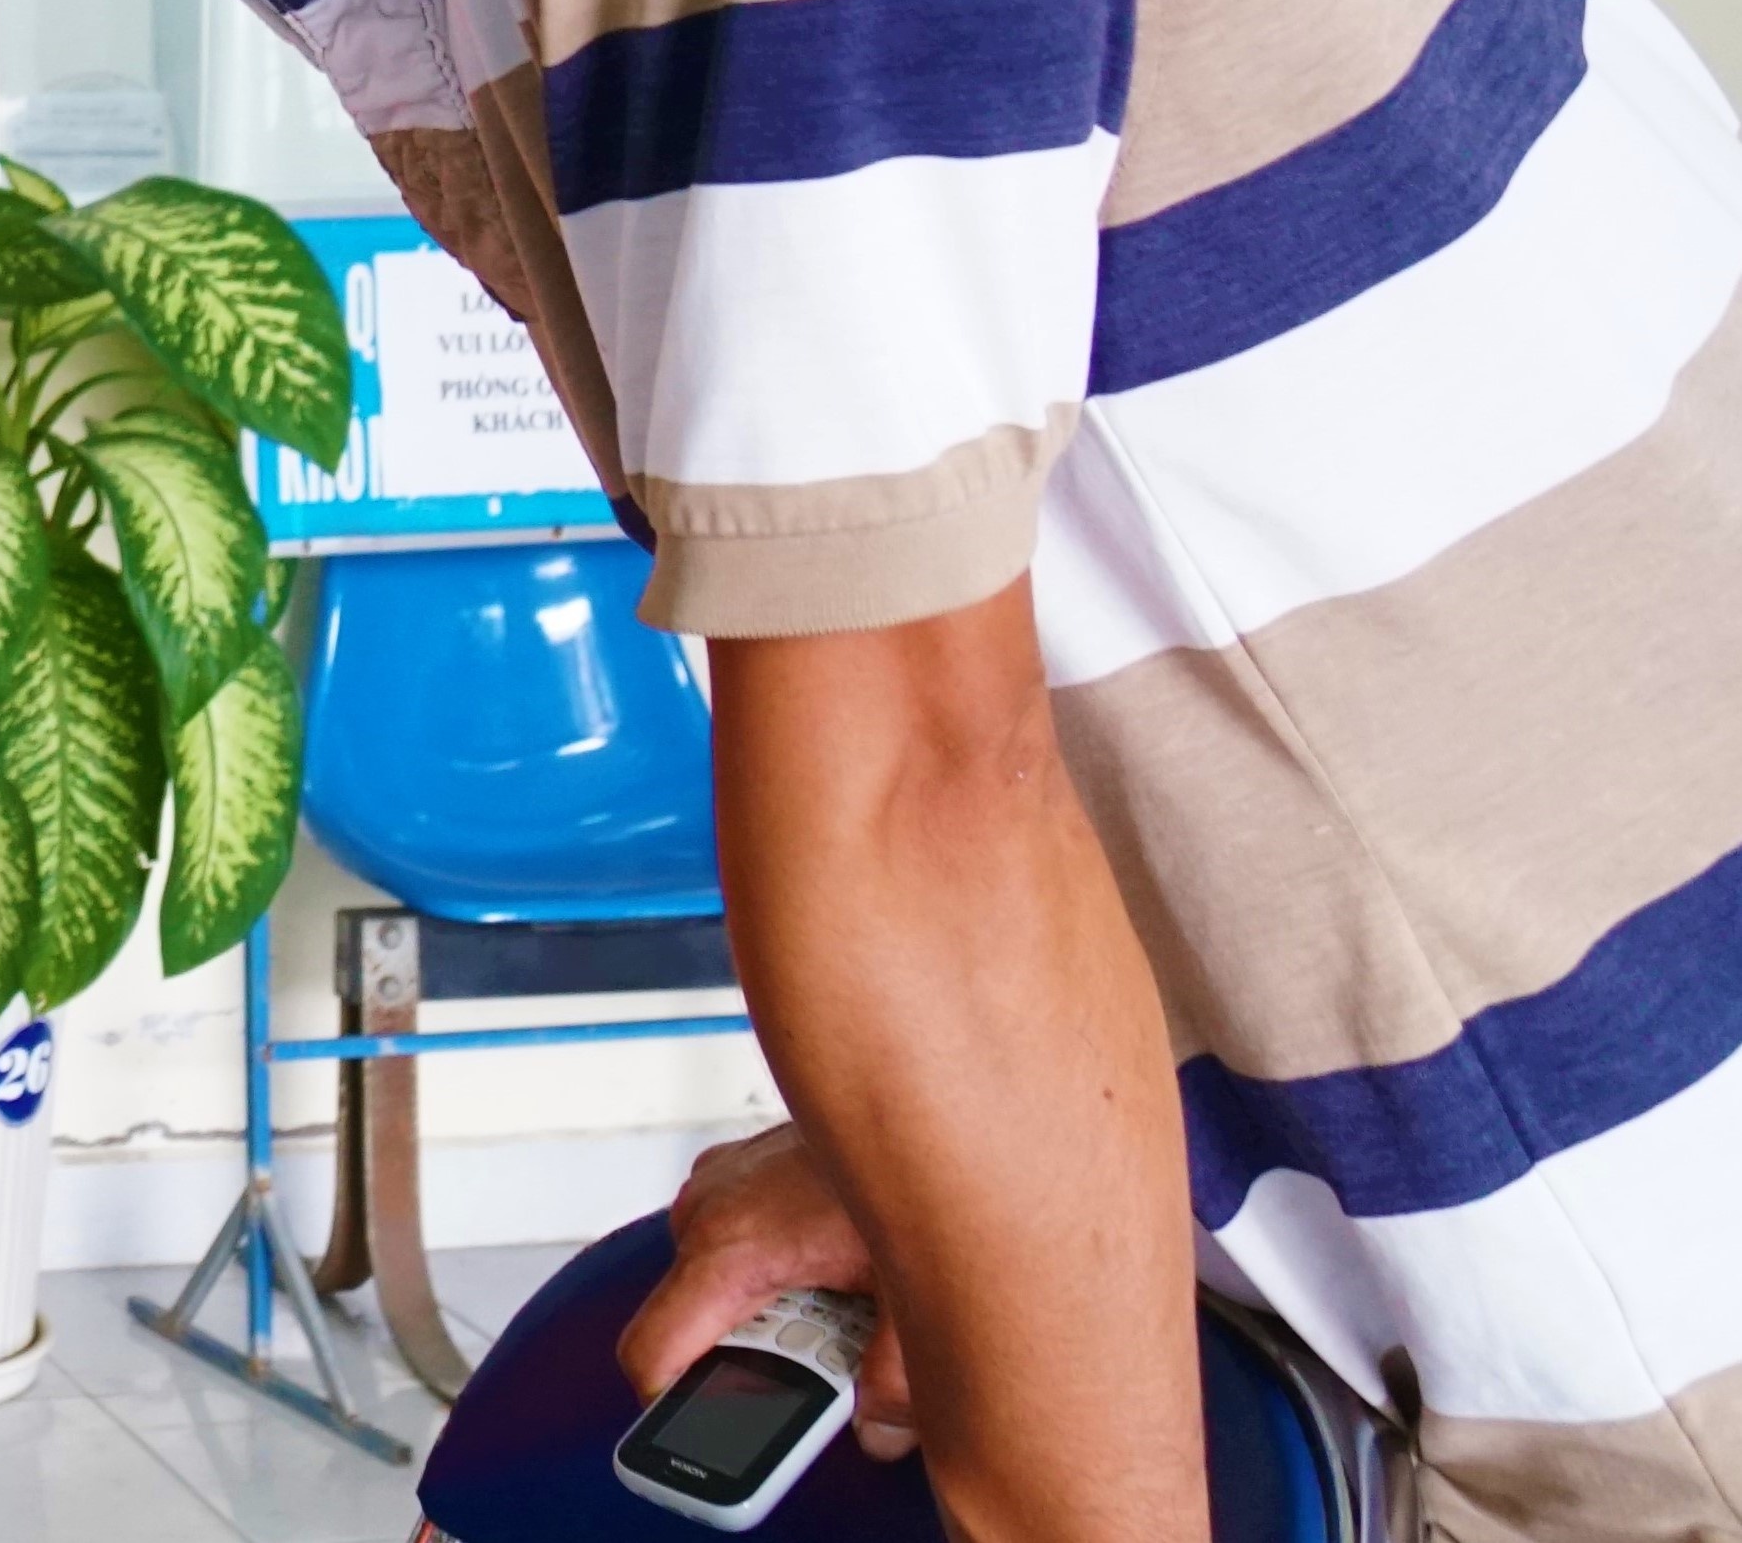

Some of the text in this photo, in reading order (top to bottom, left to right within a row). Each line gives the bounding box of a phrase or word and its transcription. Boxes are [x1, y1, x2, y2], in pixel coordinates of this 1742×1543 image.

[438, 332, 482, 354] VUI
[440, 374, 529, 401] PHÒNG
[472, 405, 564, 434] KHÁCH
